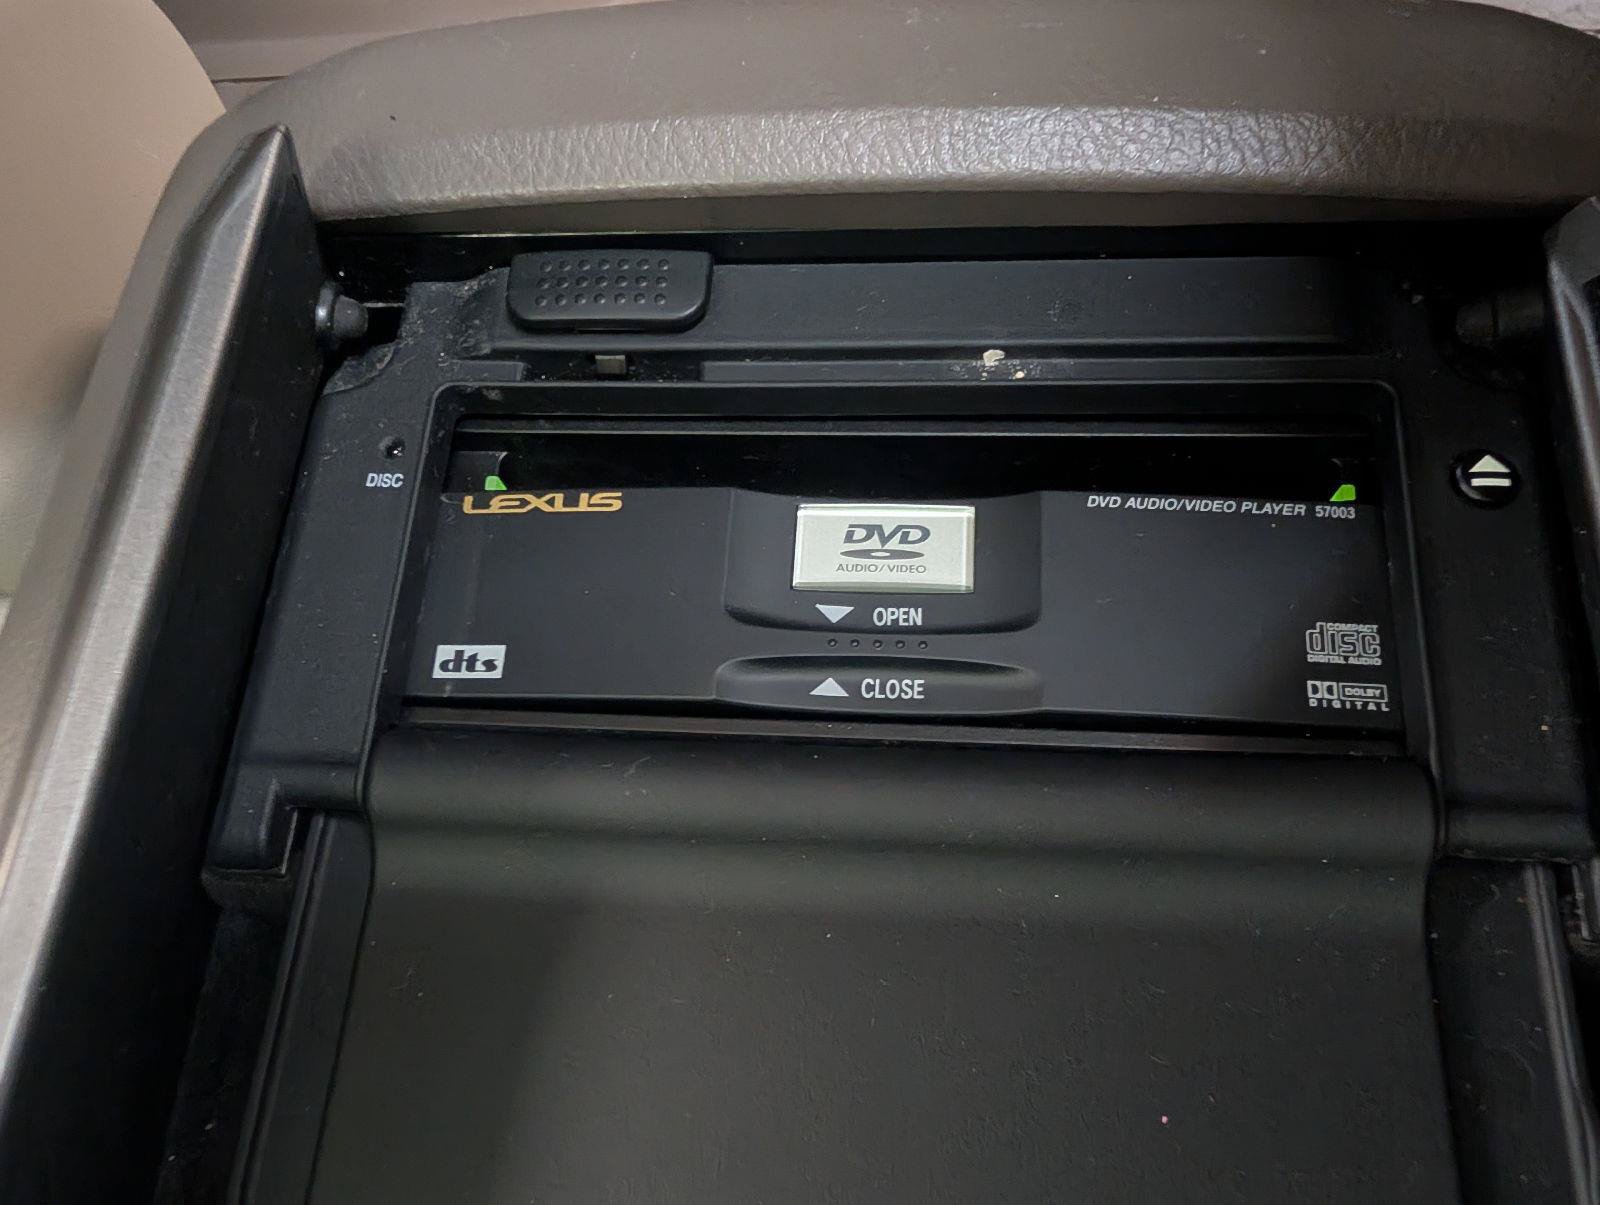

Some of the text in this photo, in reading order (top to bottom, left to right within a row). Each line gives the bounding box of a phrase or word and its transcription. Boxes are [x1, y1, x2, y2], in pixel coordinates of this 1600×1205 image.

[365, 472, 404, 487] DISC
[463, 492, 623, 514] LEXUS
[1087, 495, 1355, 519] DVD AUDIO/VIDEO PLAYER 57003
[843, 524, 931, 547] DVD
[835, 563, 926, 574] AUDIO/VIDEO
[872, 607, 923, 626] OPEN
[438, 650, 498, 673] dts
[861, 678, 925, 699] CLOSE
[1309, 698, 1390, 711] DIGITAL
